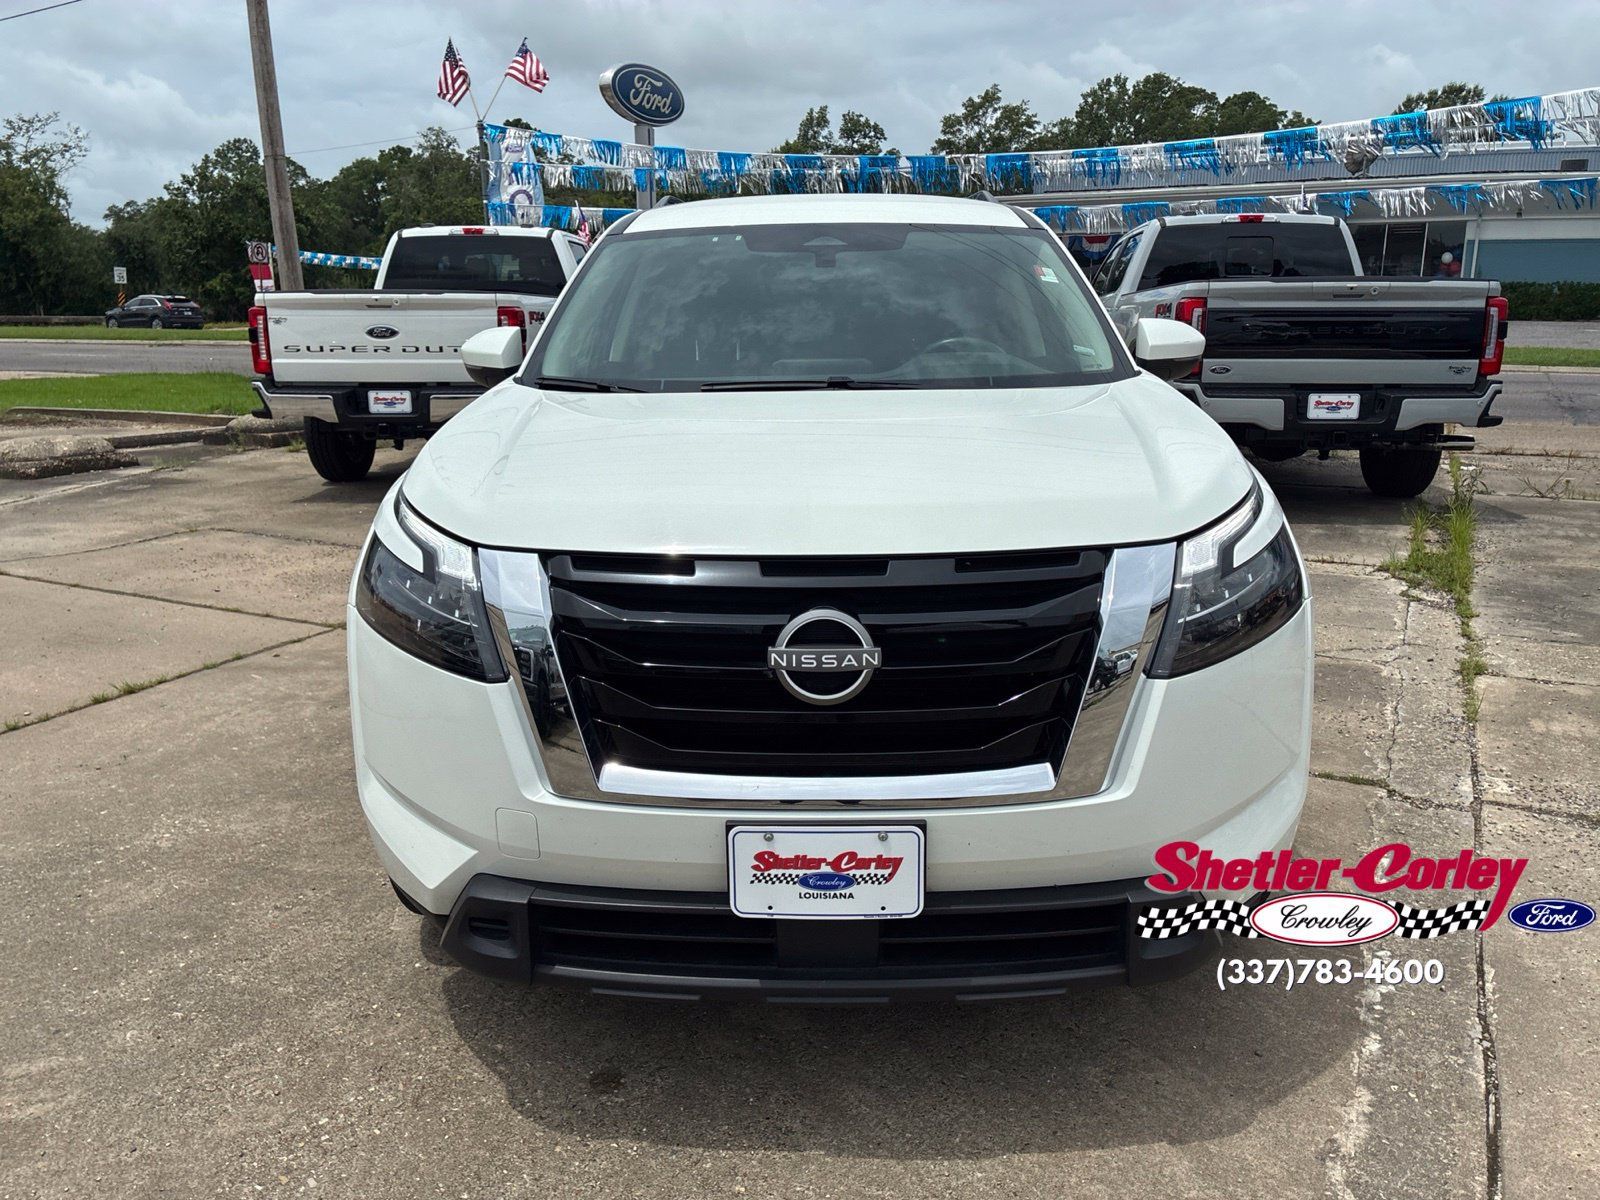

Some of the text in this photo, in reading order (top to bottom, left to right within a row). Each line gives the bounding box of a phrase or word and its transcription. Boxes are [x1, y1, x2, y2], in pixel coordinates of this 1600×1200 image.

[630, 73, 673, 114] Ford
[283, 345, 462, 353] SUPER DUT
[771, 652, 879, 668] NISSAN
[751, 850, 904, 884] Shetler-Corley
[807, 876, 847, 889] Crowley
[798, 892, 854, 900] LOUISIANA
